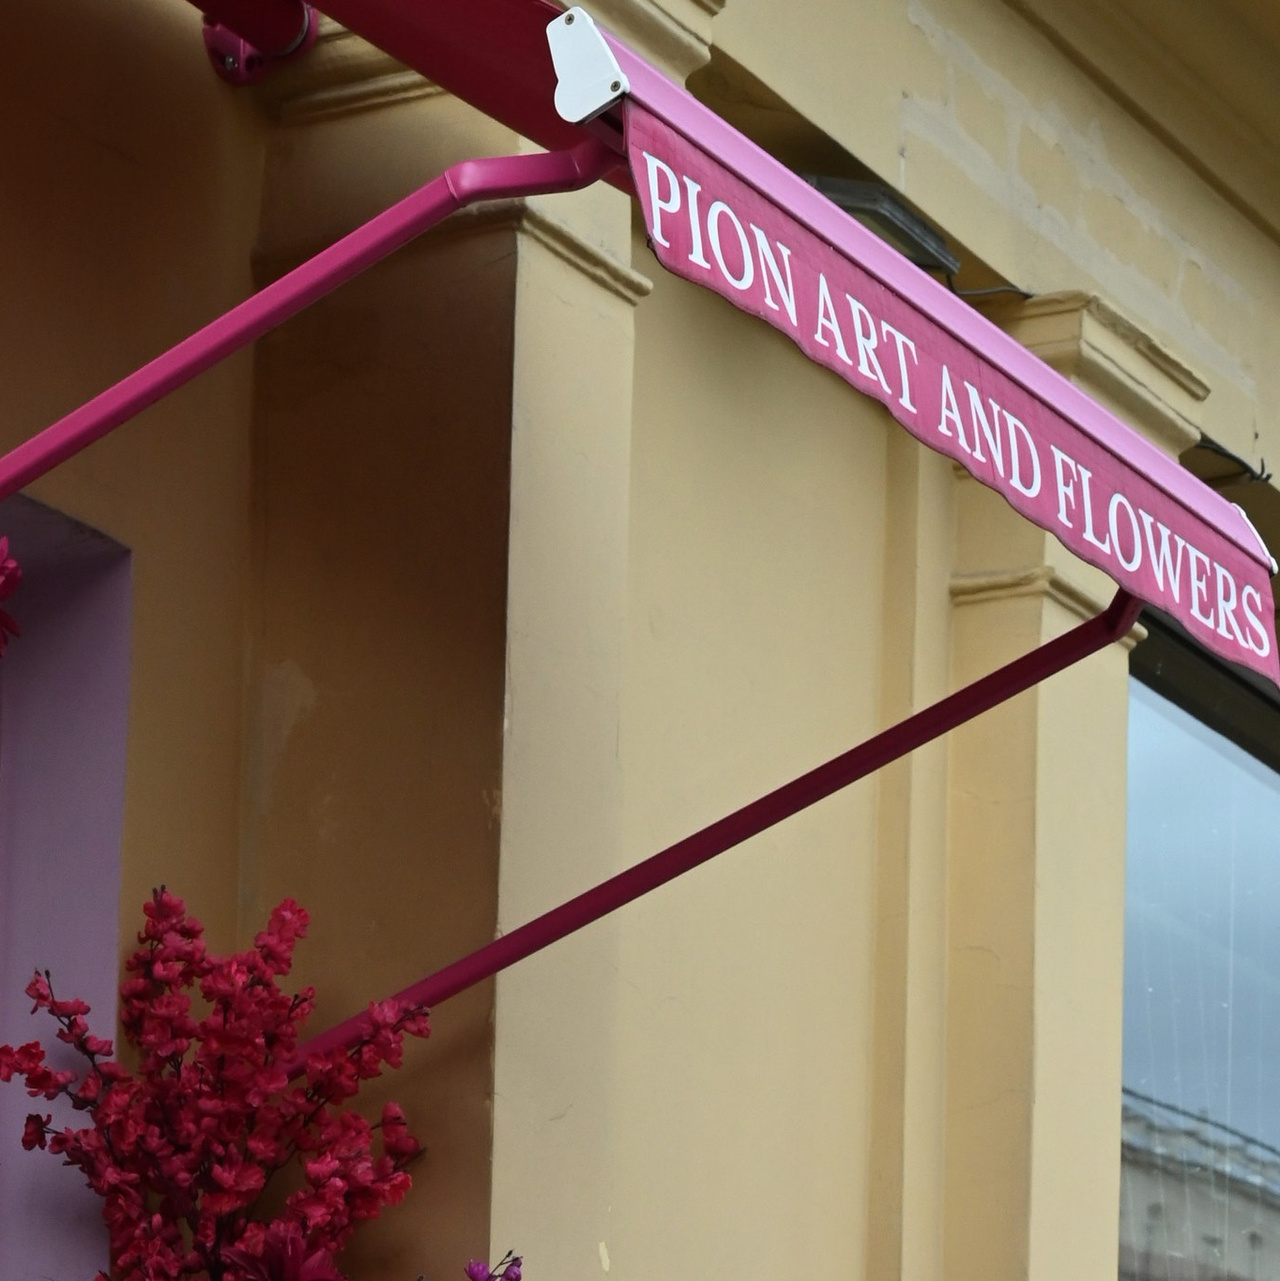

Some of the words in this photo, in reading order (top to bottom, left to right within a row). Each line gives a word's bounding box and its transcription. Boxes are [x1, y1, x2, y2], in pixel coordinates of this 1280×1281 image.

[642, 150, 798, 327] PION
[813, 272, 919, 415] ART
[937, 364, 1042, 499] AND
[1050, 444, 1271, 658] FLOWERS
